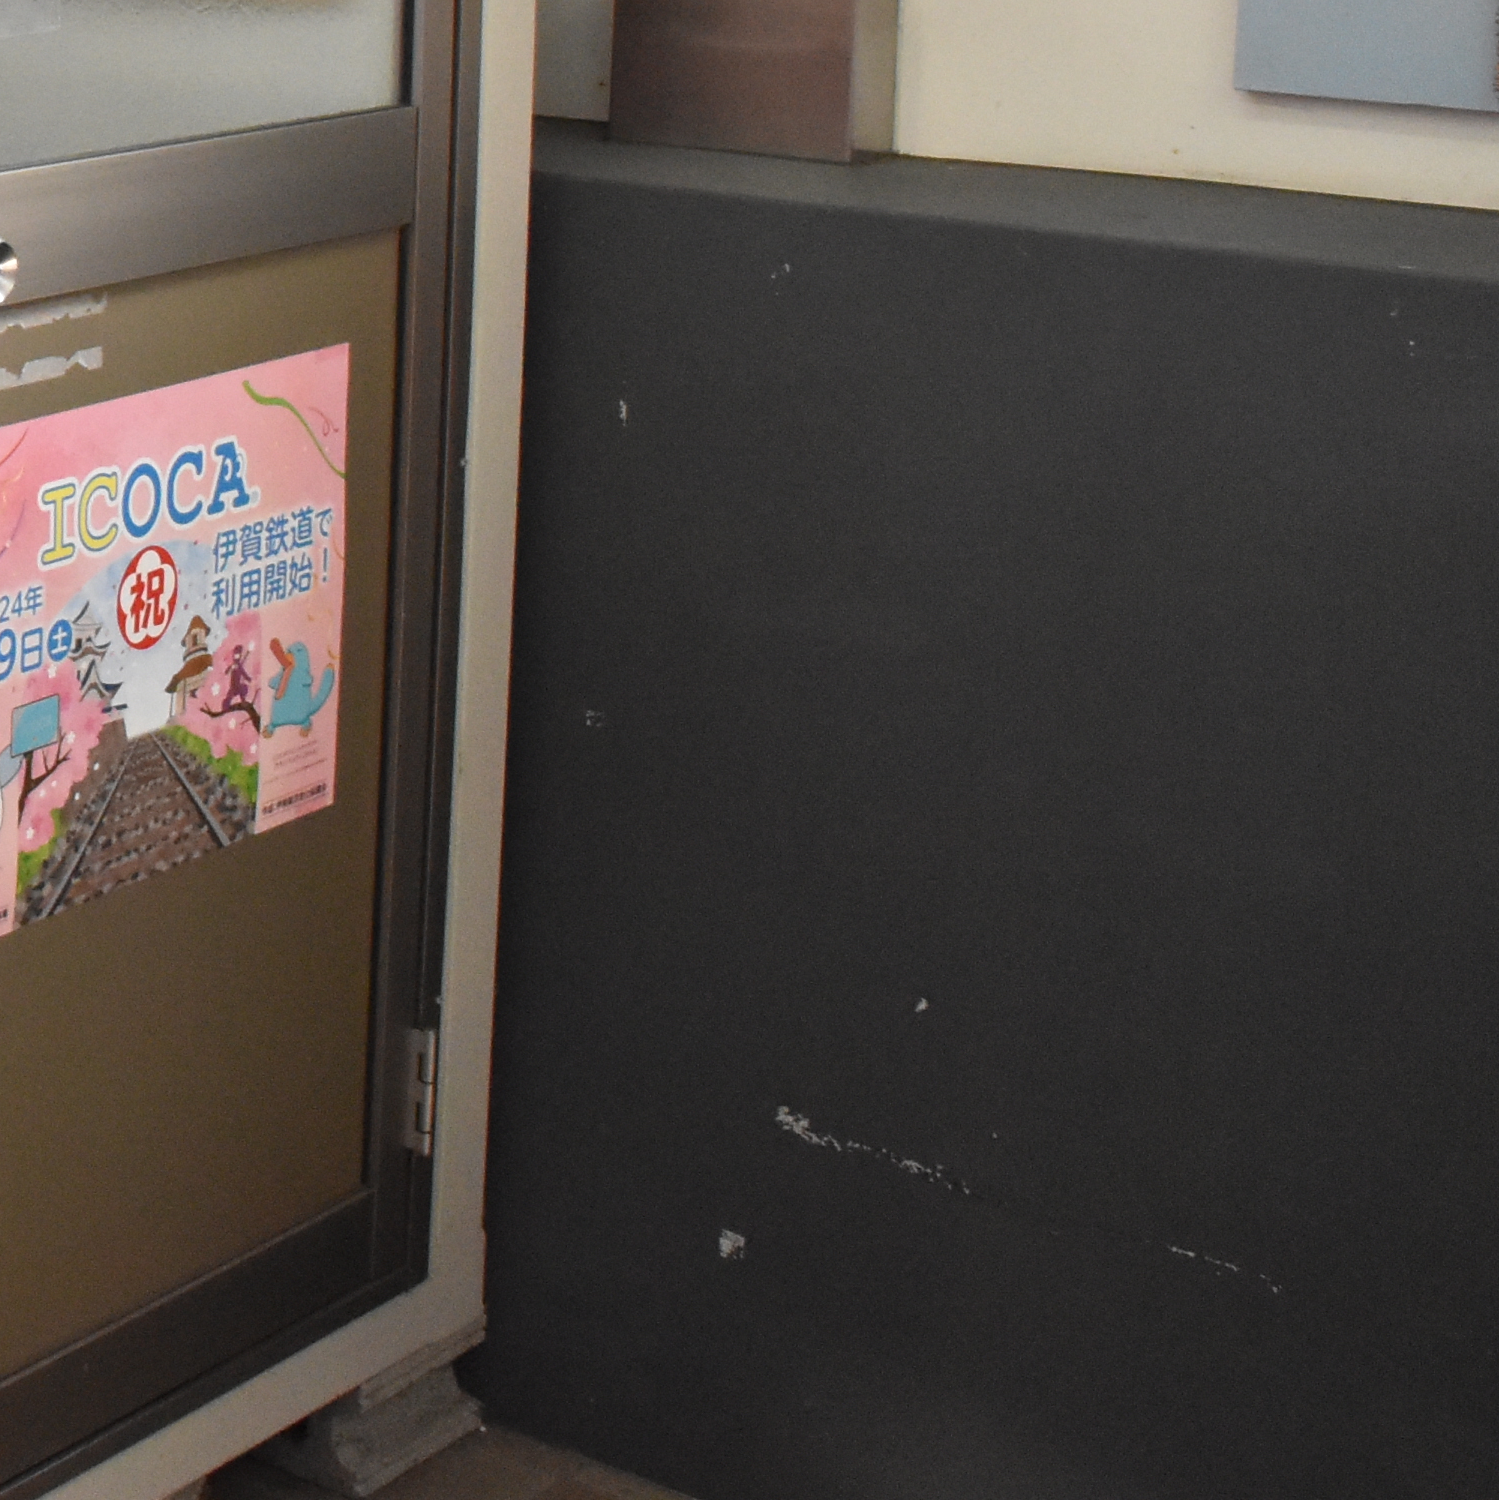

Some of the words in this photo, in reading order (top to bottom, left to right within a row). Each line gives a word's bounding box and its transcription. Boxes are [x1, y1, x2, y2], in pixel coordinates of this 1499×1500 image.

[41, 441, 251, 563] ICOCA
[213, 506, 334, 574] 伊賀鉄道で
[130, 567, 166, 632] 祝
[211, 548, 331, 621] 利用開始!
